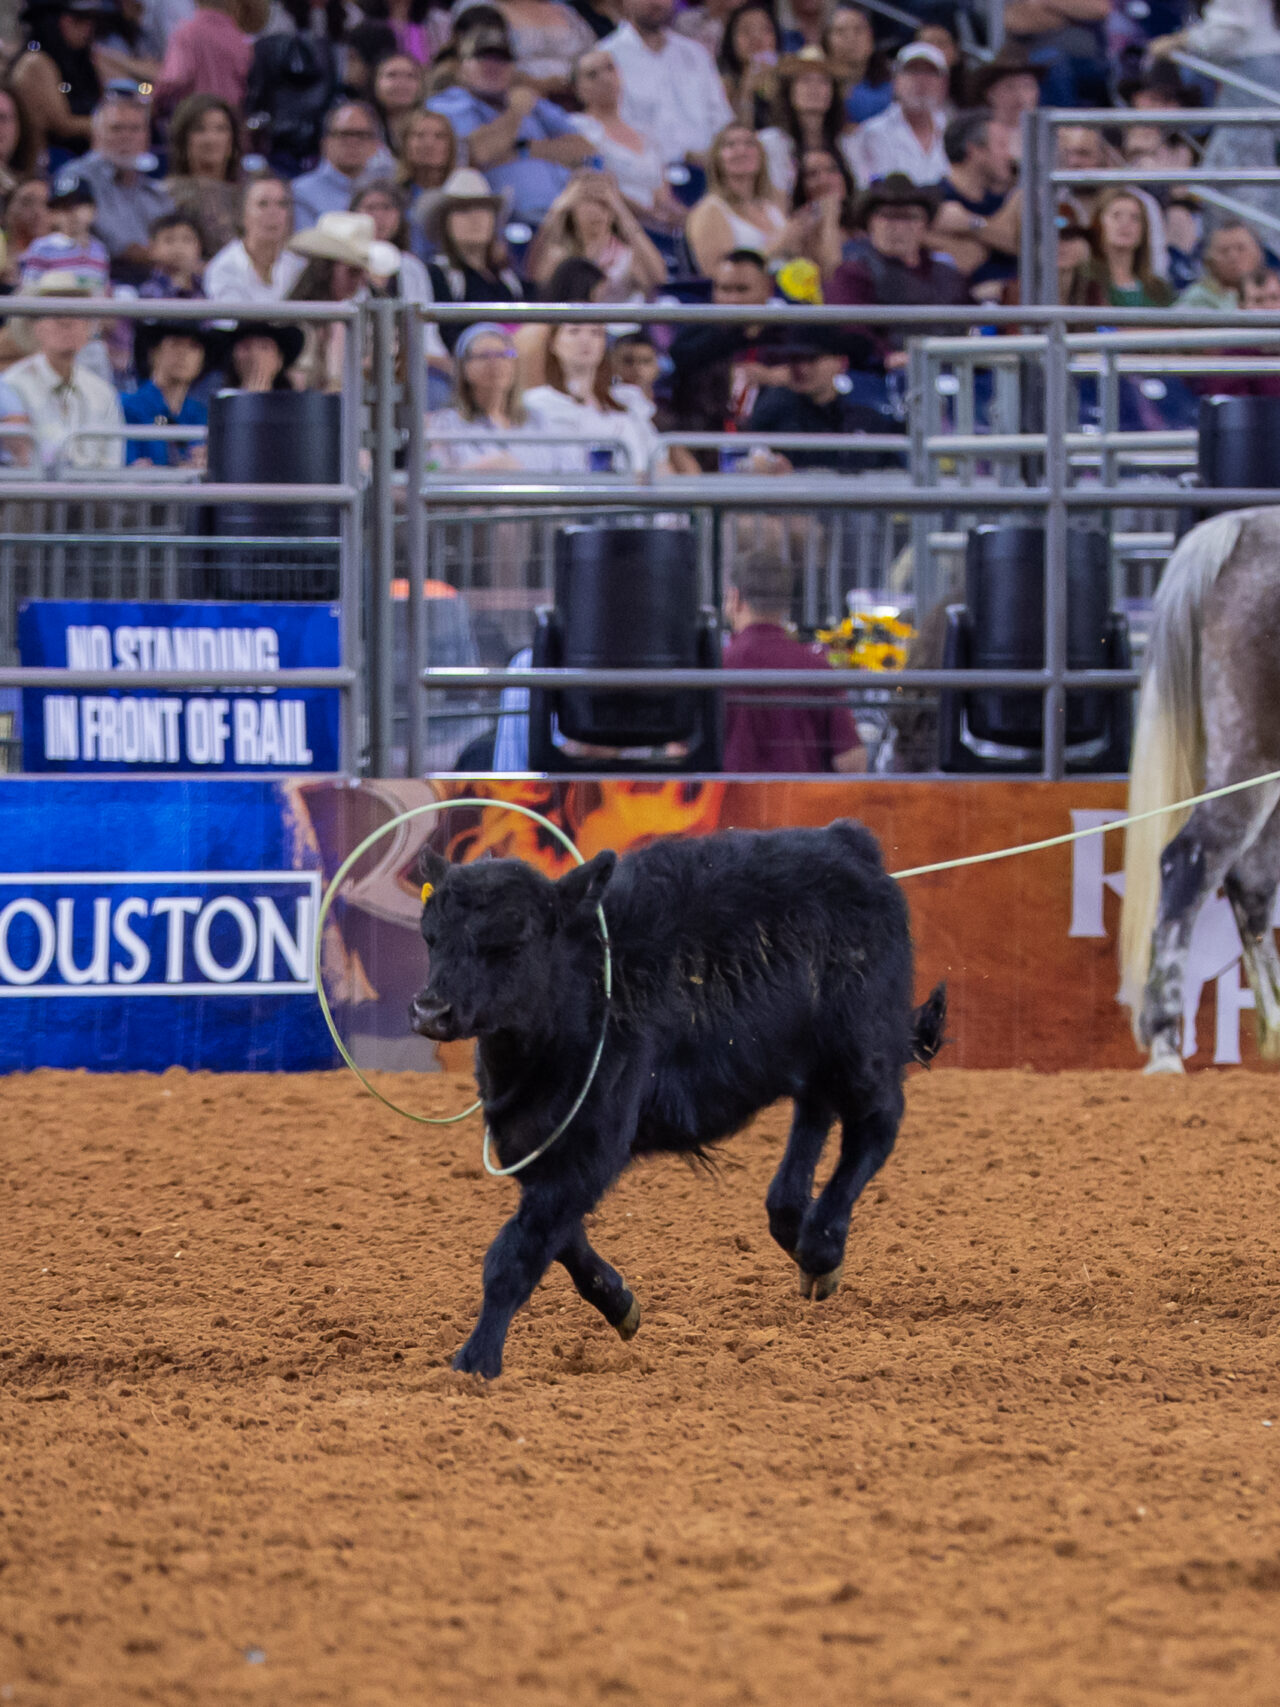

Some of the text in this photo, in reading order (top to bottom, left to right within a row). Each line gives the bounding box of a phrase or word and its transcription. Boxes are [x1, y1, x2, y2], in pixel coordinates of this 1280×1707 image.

[66, 625, 281, 693] NO STANDING
[44, 695, 313, 765] IN FRONT OF RAIL
